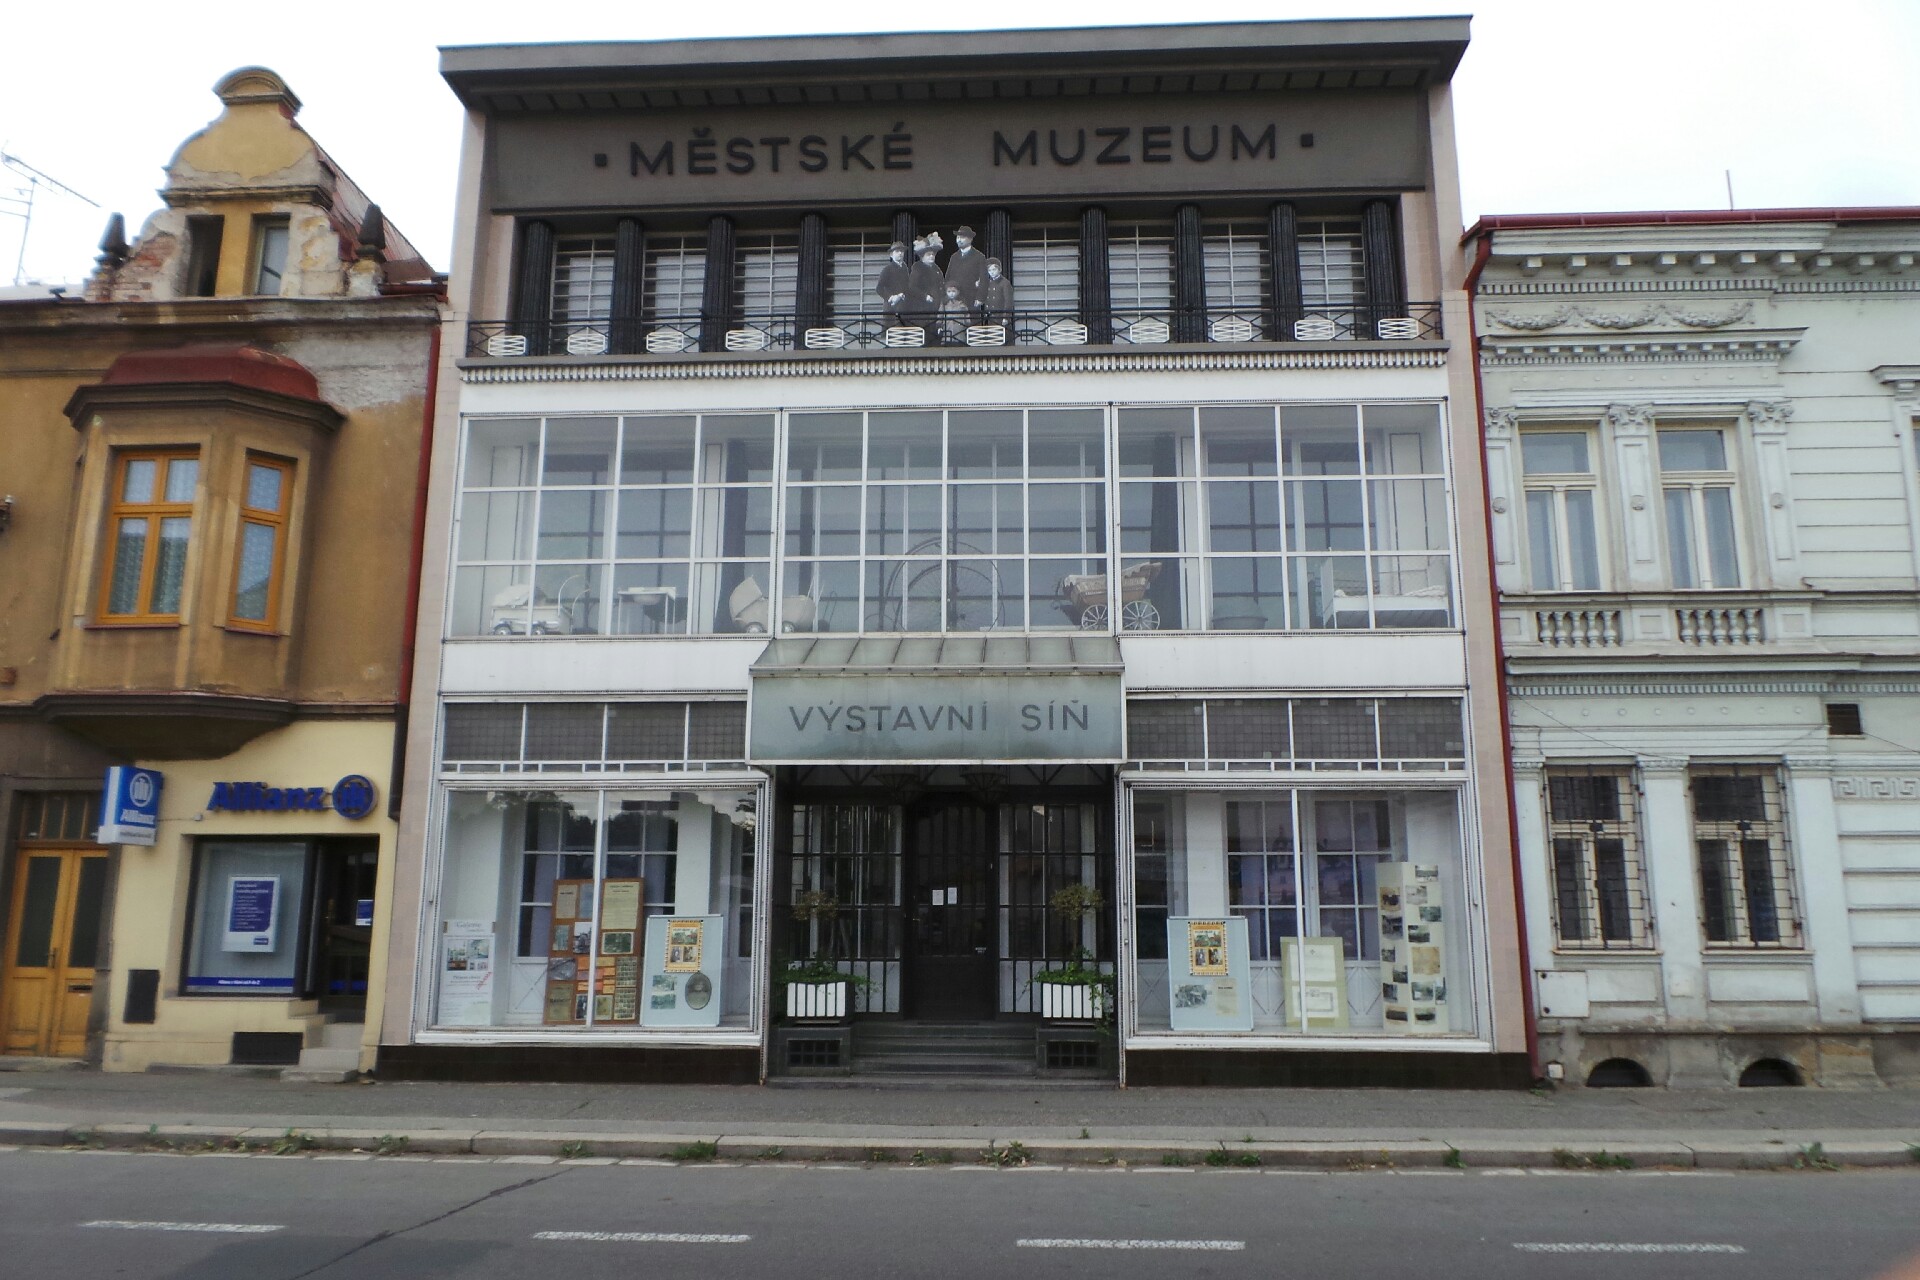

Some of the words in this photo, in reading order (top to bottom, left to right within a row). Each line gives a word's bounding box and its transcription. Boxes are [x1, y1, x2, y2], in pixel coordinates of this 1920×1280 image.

[630, 122, 913, 176] MĚSTSKÉ
[993, 123, 1277, 167] MUZEUM
[789, 700, 987, 732] VÝSTAVNÍ
[1021, 699, 1088, 731] SÍŇ
[207, 782, 325, 810] Allianz
[120, 809, 155, 824] Allianz
